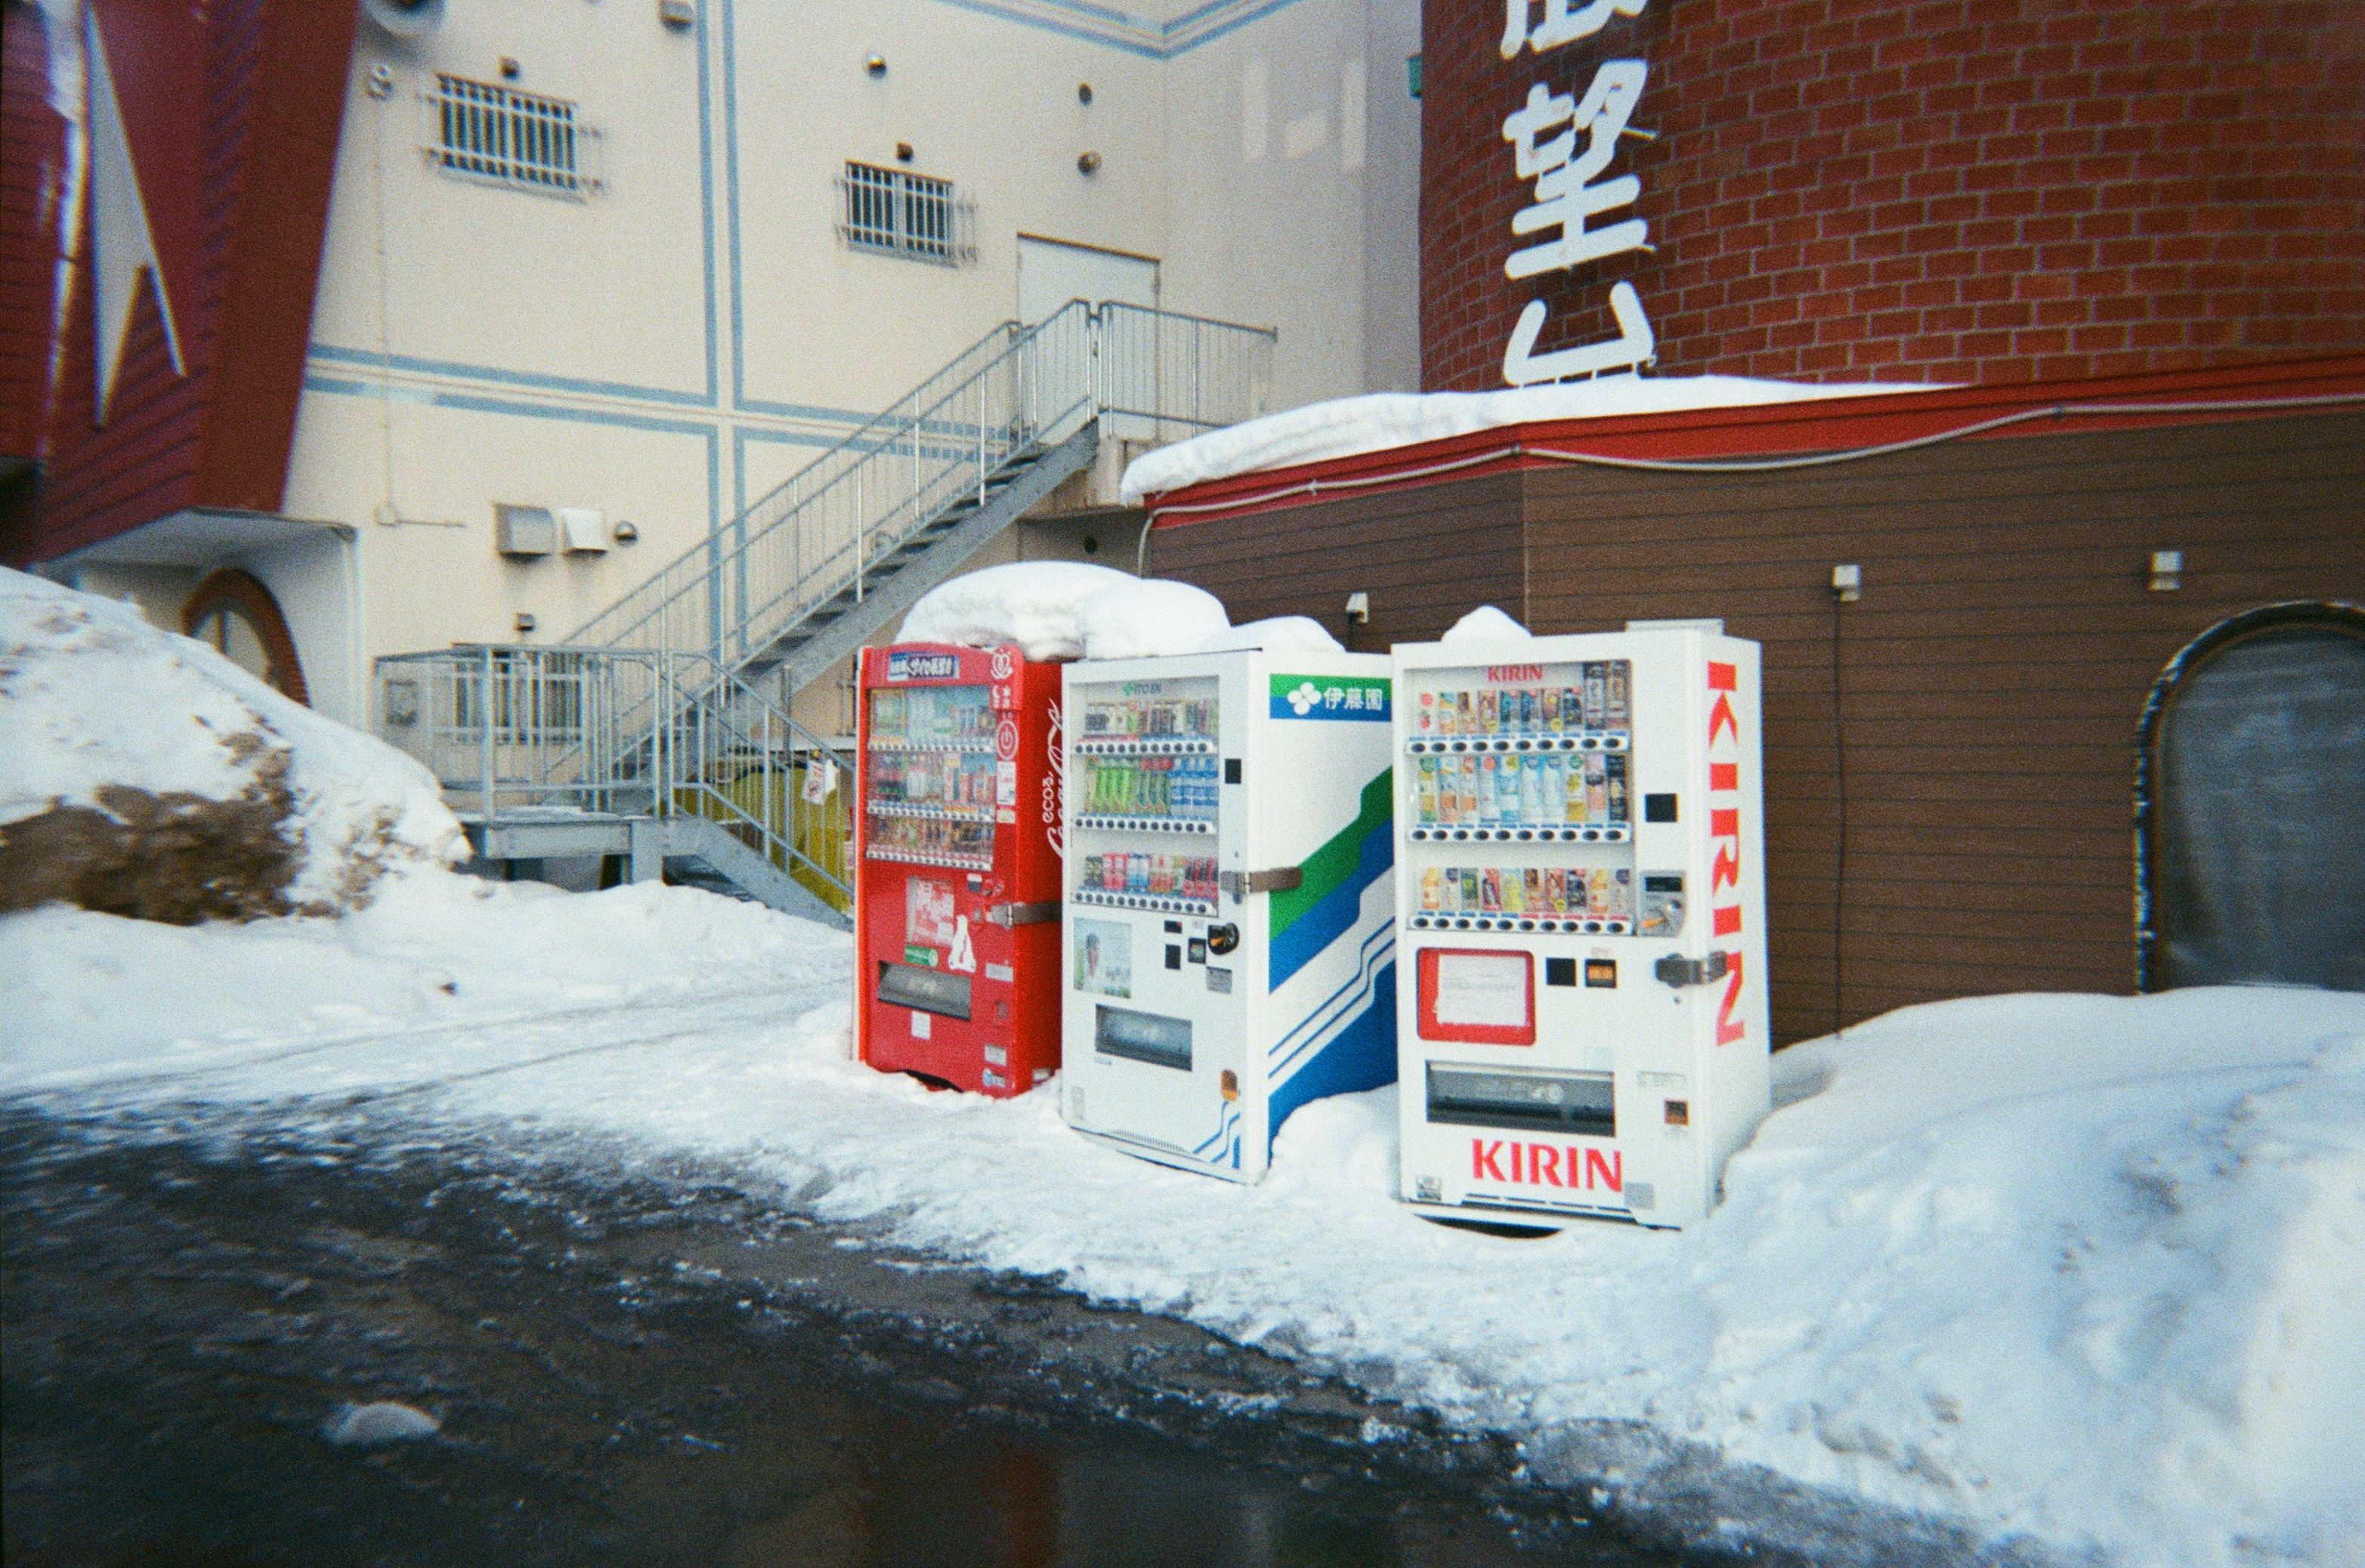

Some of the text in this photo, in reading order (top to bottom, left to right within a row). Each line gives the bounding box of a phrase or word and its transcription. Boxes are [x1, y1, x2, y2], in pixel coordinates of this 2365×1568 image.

[1487, 664, 1544, 682] KIRIN
[1322, 686, 1383, 711] 伊藤園
[1707, 660, 1746, 1047] KIRIN
[1471, 1137, 1623, 1193] KIRIN
